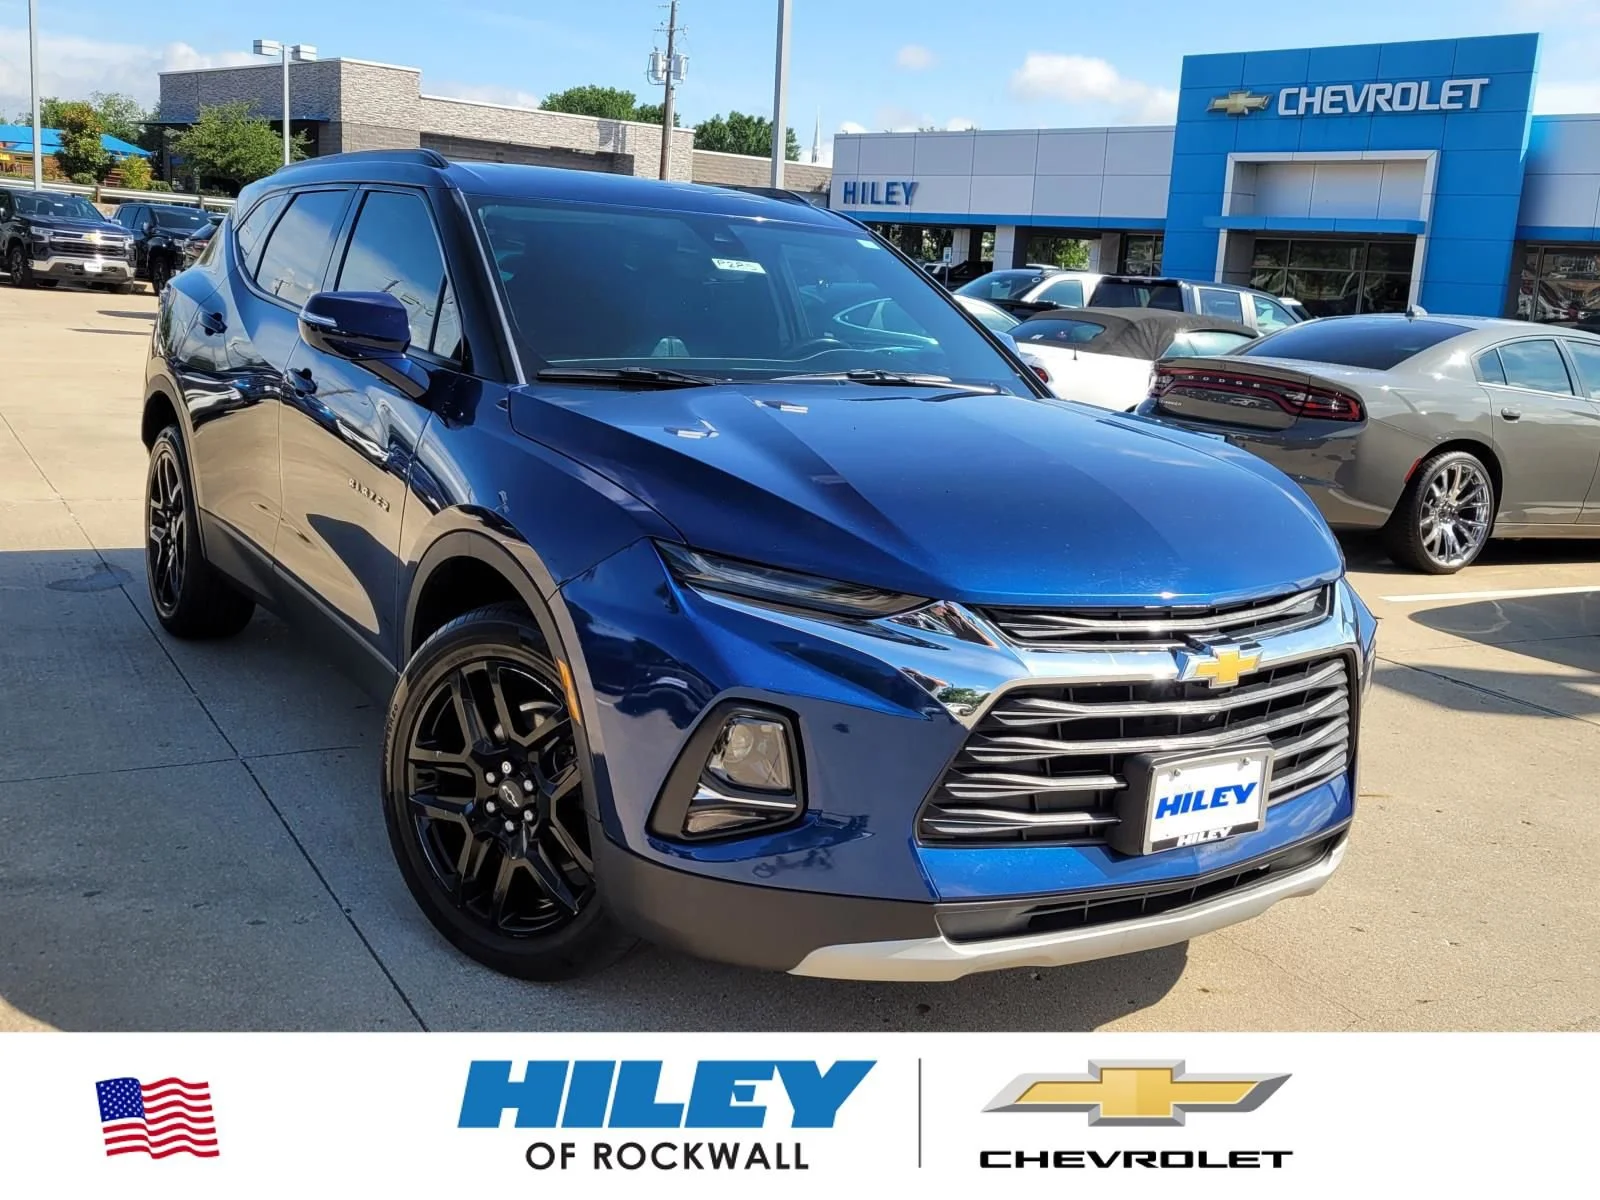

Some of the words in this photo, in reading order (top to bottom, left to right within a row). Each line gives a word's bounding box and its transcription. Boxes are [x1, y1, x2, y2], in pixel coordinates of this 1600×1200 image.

[1278, 78, 1489, 116] CHEVROLET
[843, 181, 918, 205] HILEY
[1188, 374, 1260, 388] DODGE
[349, 478, 390, 512] BLAZER
[1155, 782, 1257, 820] HILEY
[1176, 826, 1233, 847] HILEY
